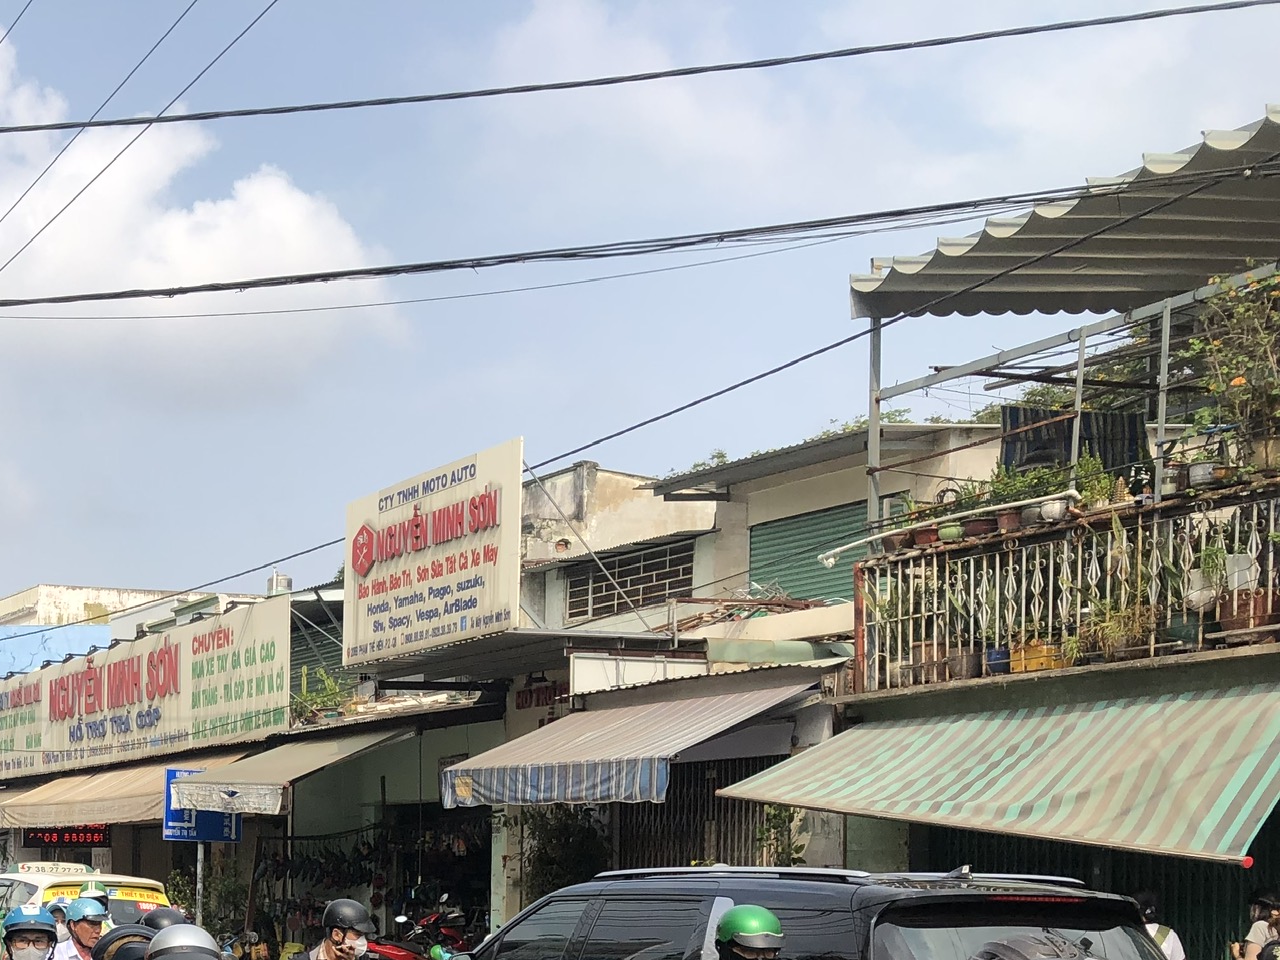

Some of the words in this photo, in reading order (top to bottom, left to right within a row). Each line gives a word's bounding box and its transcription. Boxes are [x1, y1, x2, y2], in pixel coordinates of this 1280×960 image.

[378, 494, 394, 512] CTY
[397, 485, 419, 506] TNHH
[422, 474, 448, 495] MOTO
[450, 463, 477, 484] AUTO
[431, 500, 466, 546] MINH
[468, 485, 500, 534] SƠN
[470, 549, 480, 568] Xe
[483, 543, 499, 569] Máy
[367, 599, 392, 618] Honda,
[393, 590, 427, 608] Yamaha,
[388, 613, 413, 632] Spacy,
[416, 604, 441, 624] Vespa,
[443, 594, 478, 617] AirBlade
[191, 624, 234, 656] CHUYÊN:
[206, 656, 214, 677] XE
[217, 653, 229, 673] TAY
[231, 650, 241, 670] GA
[244, 639, 256, 667] GIÁ
[260, 641, 276, 663] CAO
[106, 655, 142, 710] MINH
[145, 638, 181, 701] SƠN
